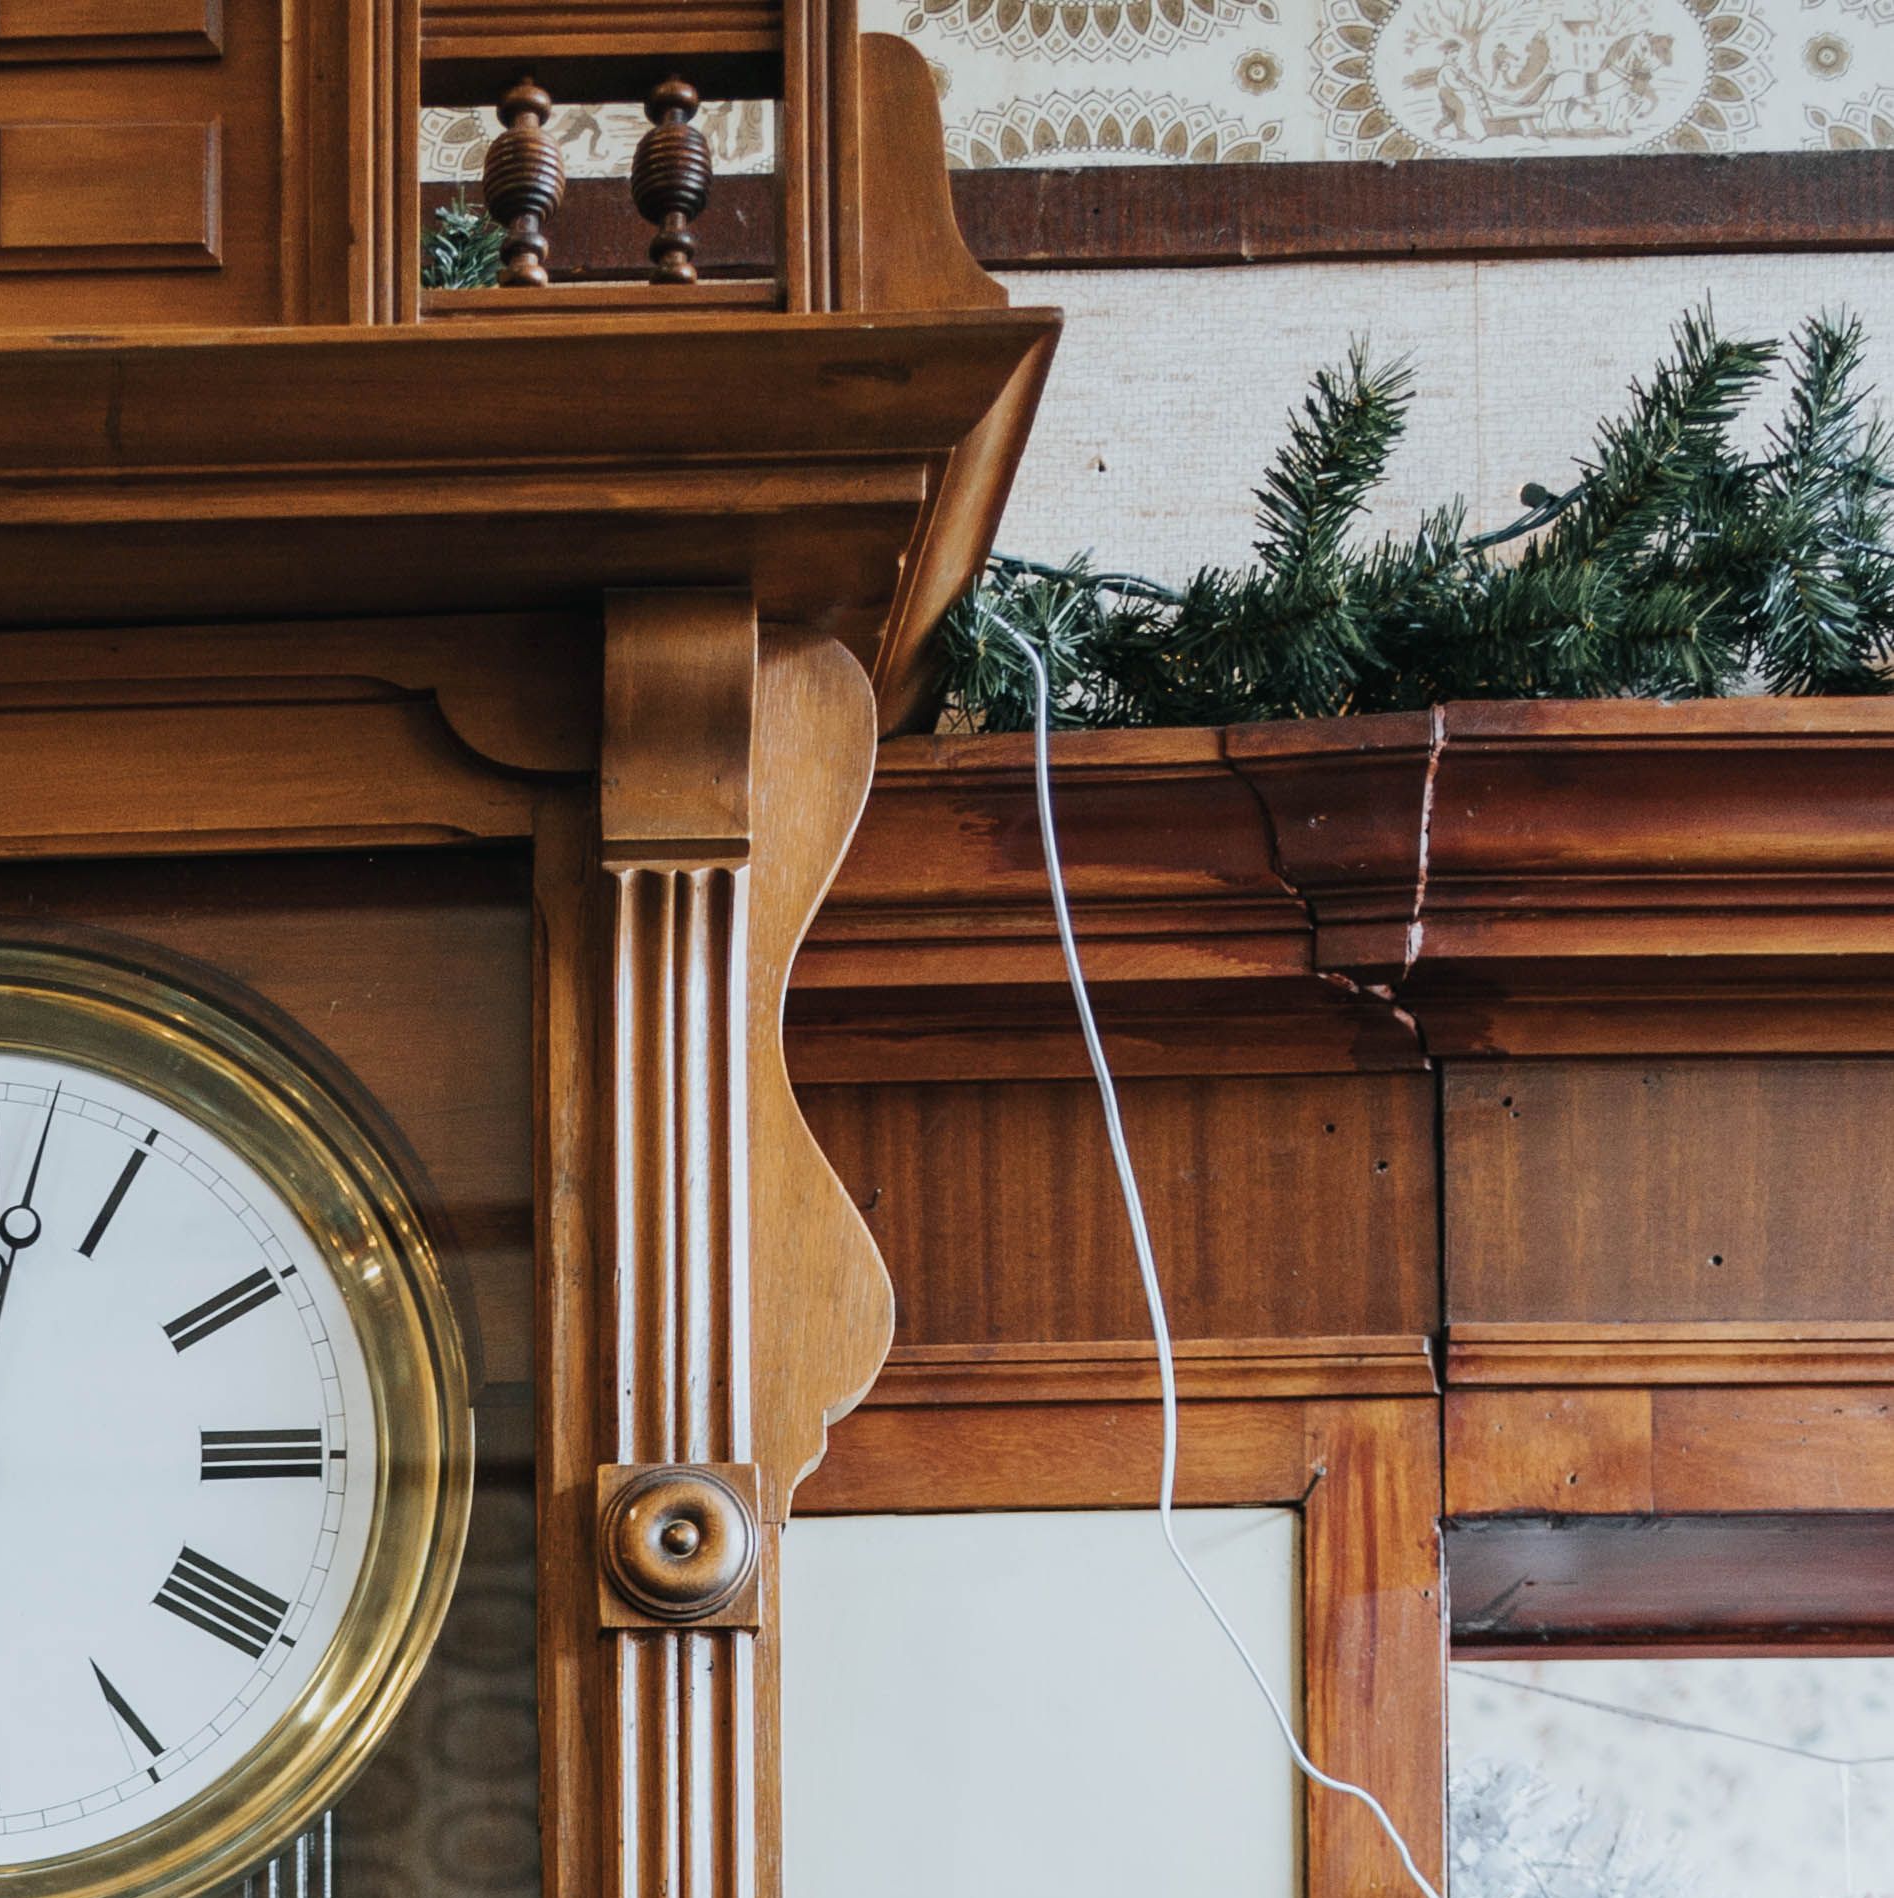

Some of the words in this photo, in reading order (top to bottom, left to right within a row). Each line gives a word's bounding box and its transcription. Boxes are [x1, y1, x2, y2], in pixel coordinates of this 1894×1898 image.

[159, 1265, 283, 1355] II
[198, 1422, 323, 1483] III
[149, 1540, 295, 1664] IIII
